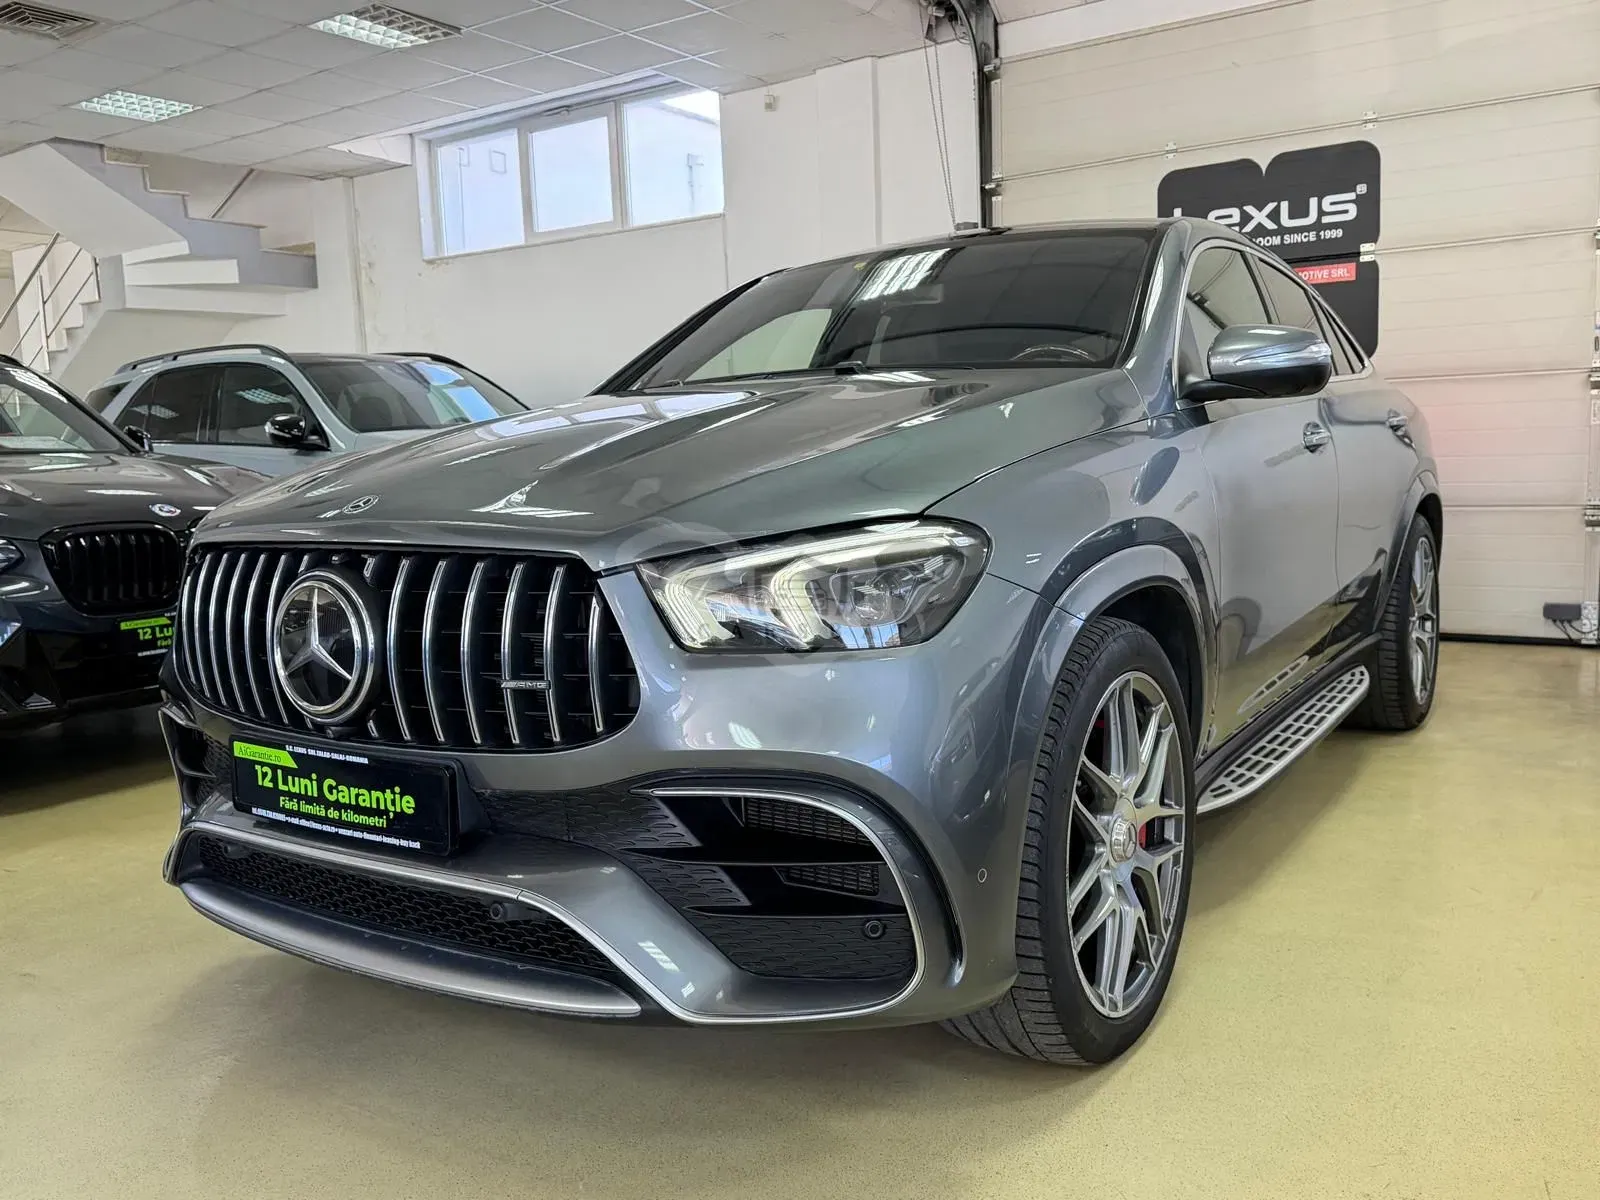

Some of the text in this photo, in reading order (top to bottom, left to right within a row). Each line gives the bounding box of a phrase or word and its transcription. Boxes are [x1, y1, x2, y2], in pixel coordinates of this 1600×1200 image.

[1283, 231, 1317, 245] SINCE
[1319, 228, 1343, 240] 1999
[1298, 267, 1350, 281] OTIVE SRL
[137, 626, 175, 640] 12 Lu
[254, 764, 274, 788] 12
[277, 768, 318, 798] Luni
[323, 778, 416, 820] Garanție
[279, 796, 298, 811] Fără
[299, 800, 326, 818] limită
[327, 806, 339, 820] de
[341, 810, 387, 828] kilometri
